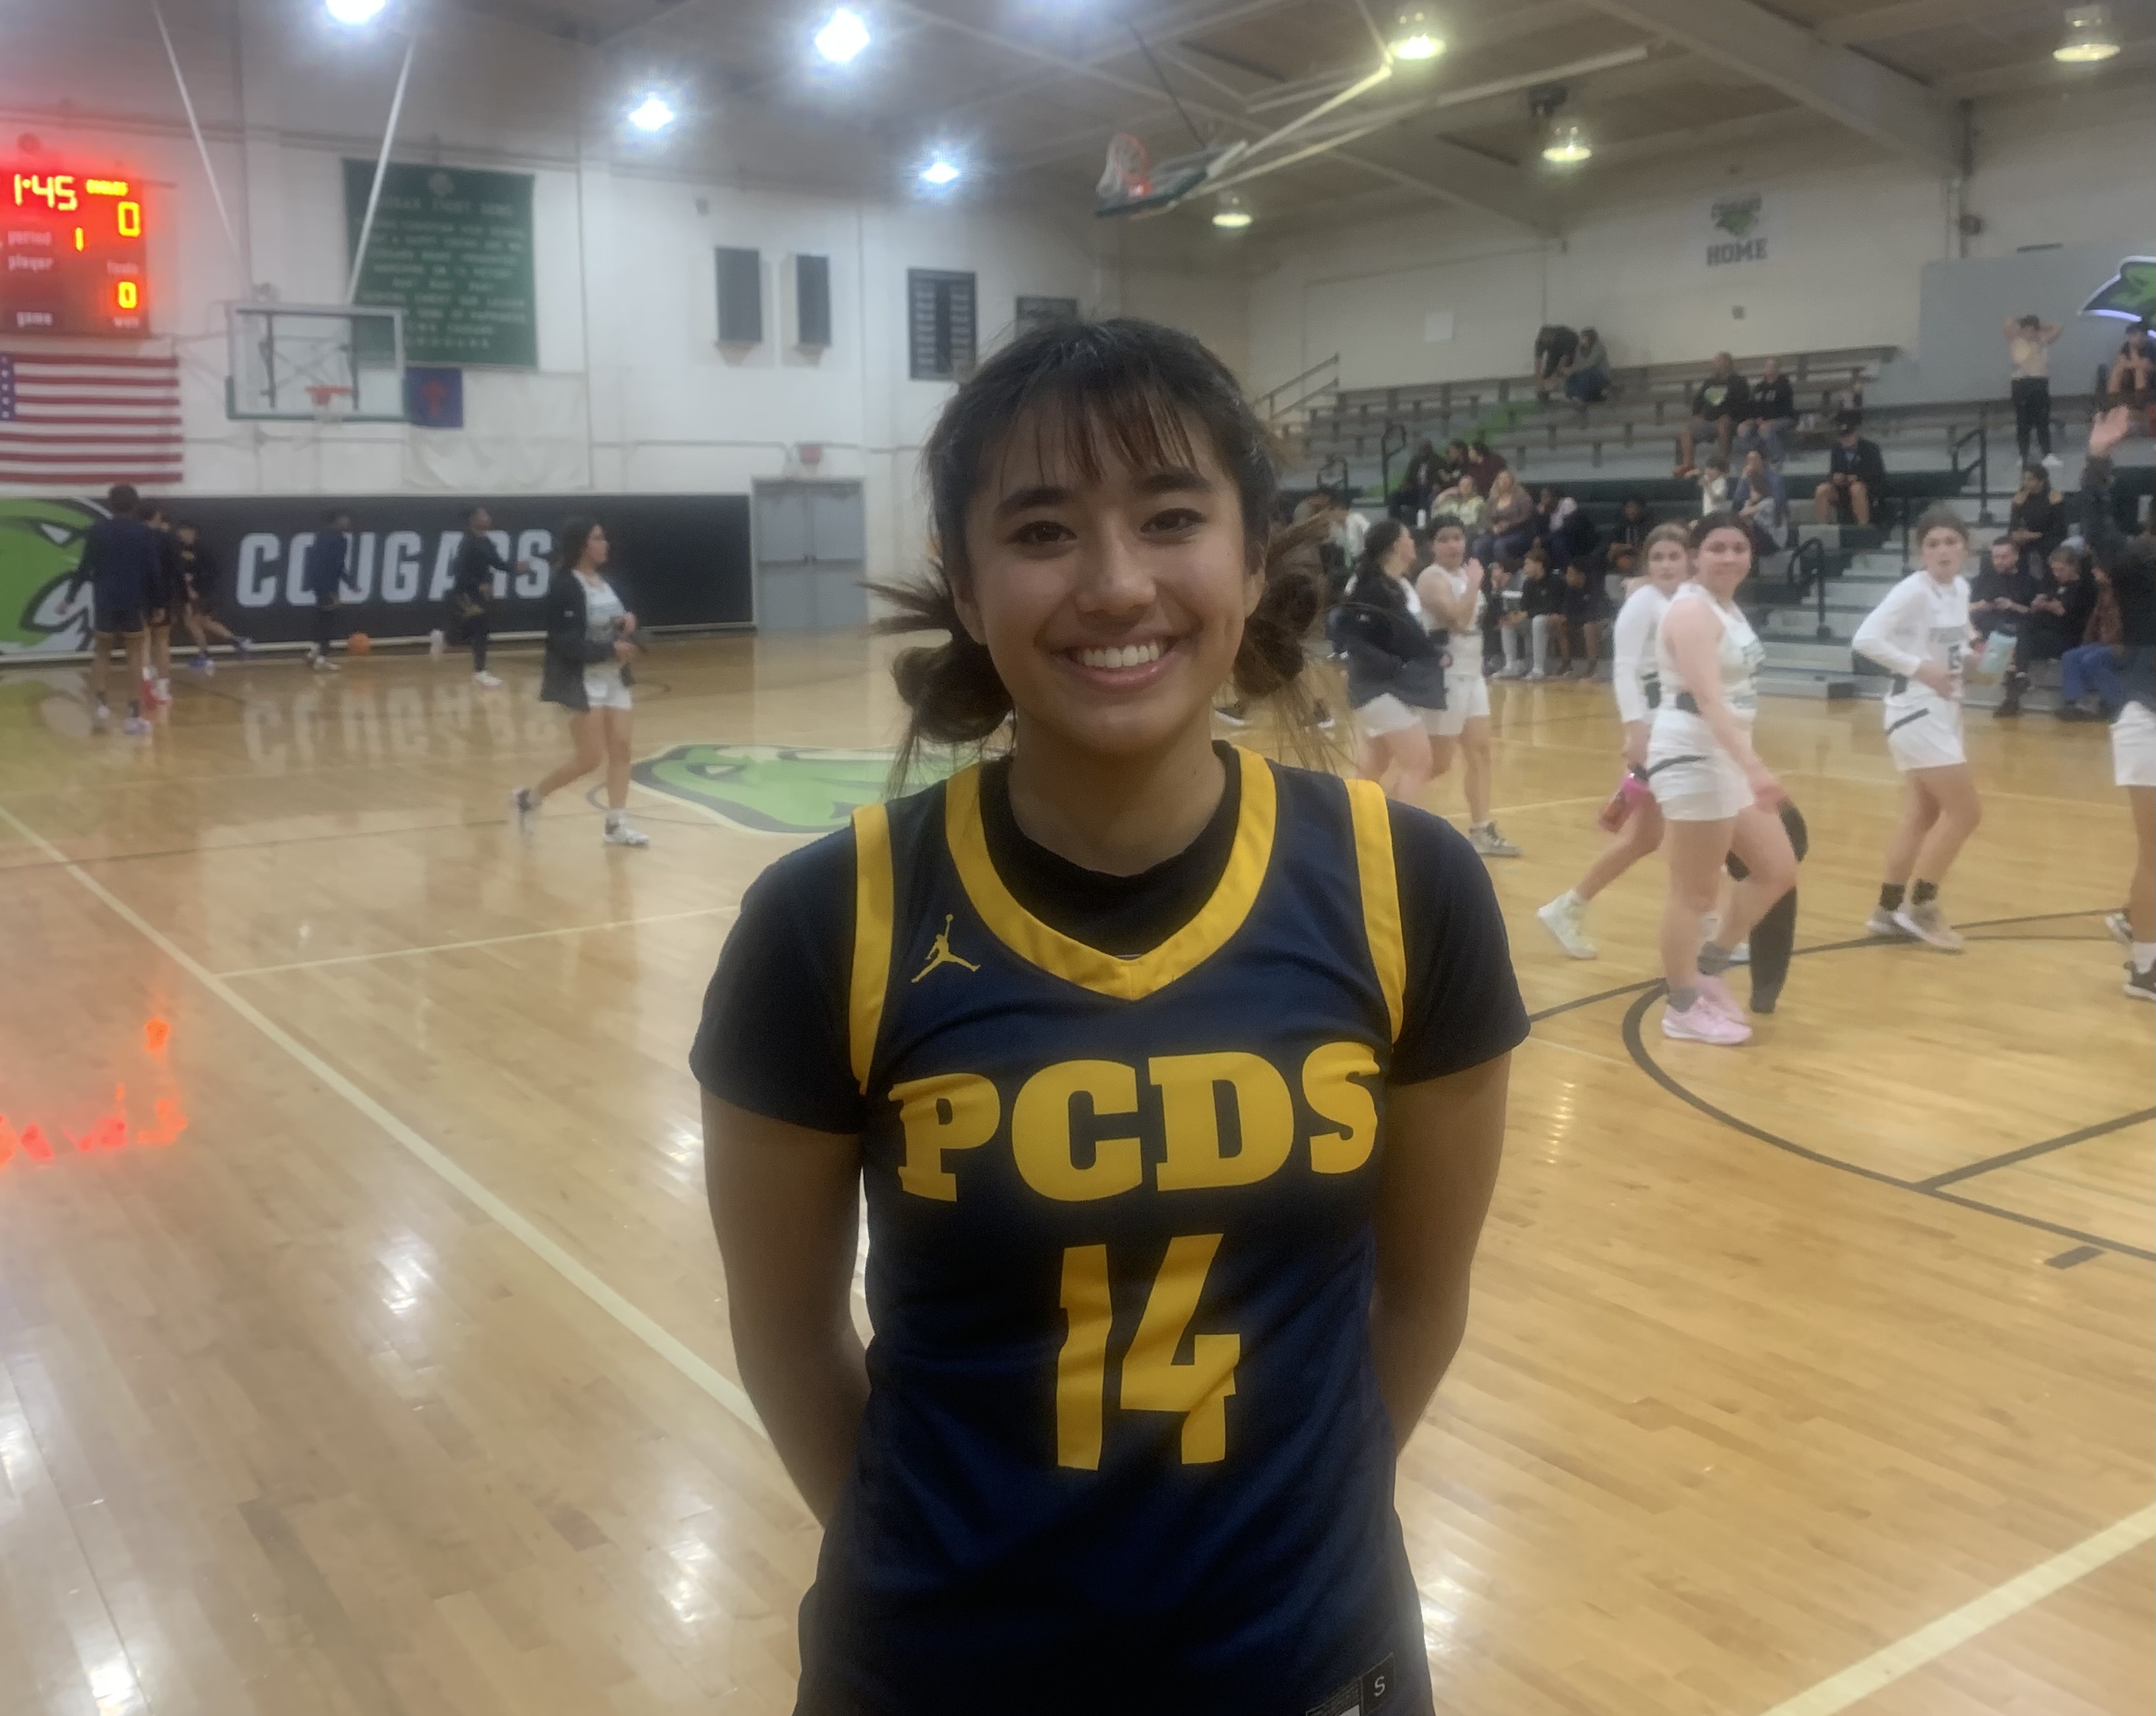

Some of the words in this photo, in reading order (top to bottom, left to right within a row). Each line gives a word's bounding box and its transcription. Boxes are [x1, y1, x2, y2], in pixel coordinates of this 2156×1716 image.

[117, 201, 141, 238] 0
[1706, 238, 1768, 267] HOME
[118, 280, 137, 309] 0
[888, 1041, 1381, 1203] PCDS
[1057, 1233, 1241, 1471] 14
[1373, 1675, 1386, 1698] S
